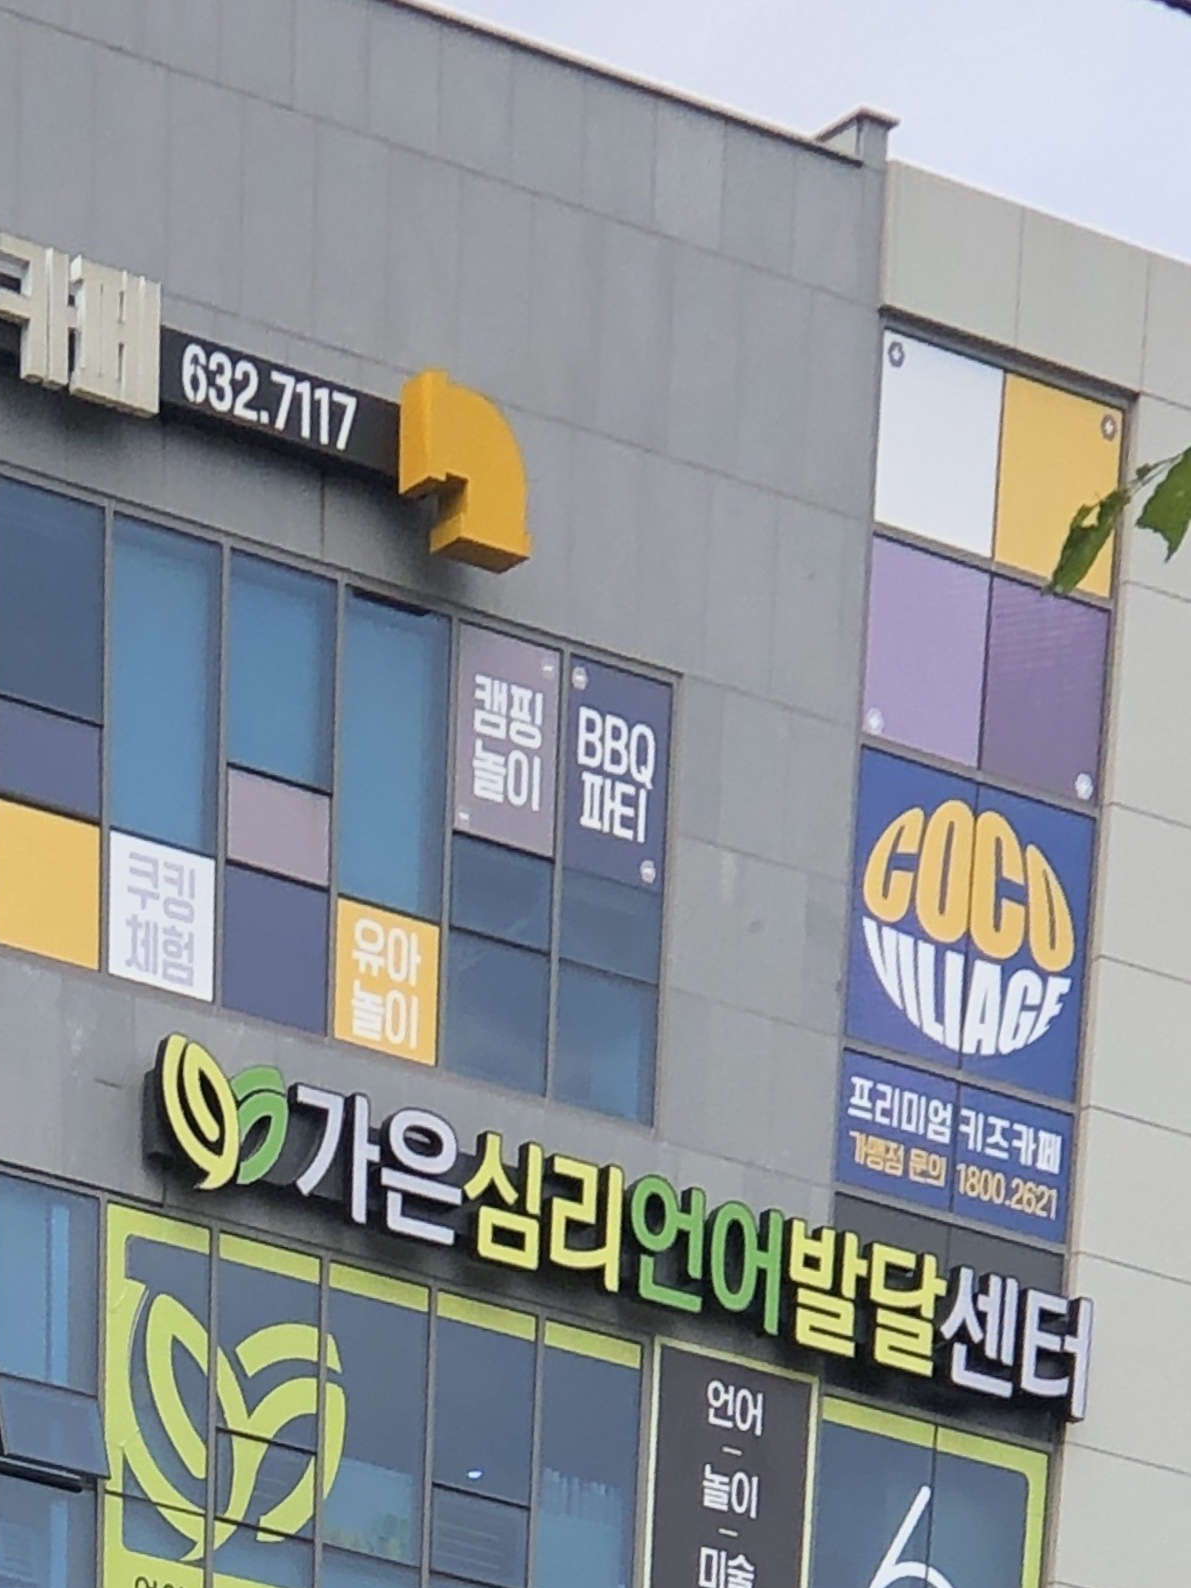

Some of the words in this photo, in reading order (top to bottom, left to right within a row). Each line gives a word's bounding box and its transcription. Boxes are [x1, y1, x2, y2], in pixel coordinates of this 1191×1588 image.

[181, 342, 358, 452] 632.7117
[473, 672, 543, 751] 캠핑
[576, 704, 656, 791] BBQ
[471, 741, 542, 812] 놀이
[579, 769, 648, 843] 파티
[127, 851, 196, 923] 쿠킹
[862, 800, 1076, 973] COCO
[124, 912, 195, 988] 체험
[352, 918, 422, 988] 유아
[862, 914, 1073, 1056] VILLAGE
[350, 979, 419, 1050] 놀이
[847, 1075, 953, 1145] 프리미엄
[958, 1107, 1063, 1175] 키즈카페
[909, 1147, 948, 1188] 문의
[956, 1162, 1059, 1222] 1800.2621
[288, 1081, 1095, 1423] 가은심리언어발달센터
[706, 1378, 764, 1437] 언어
[702, 1464, 759, 1520] 놀이
